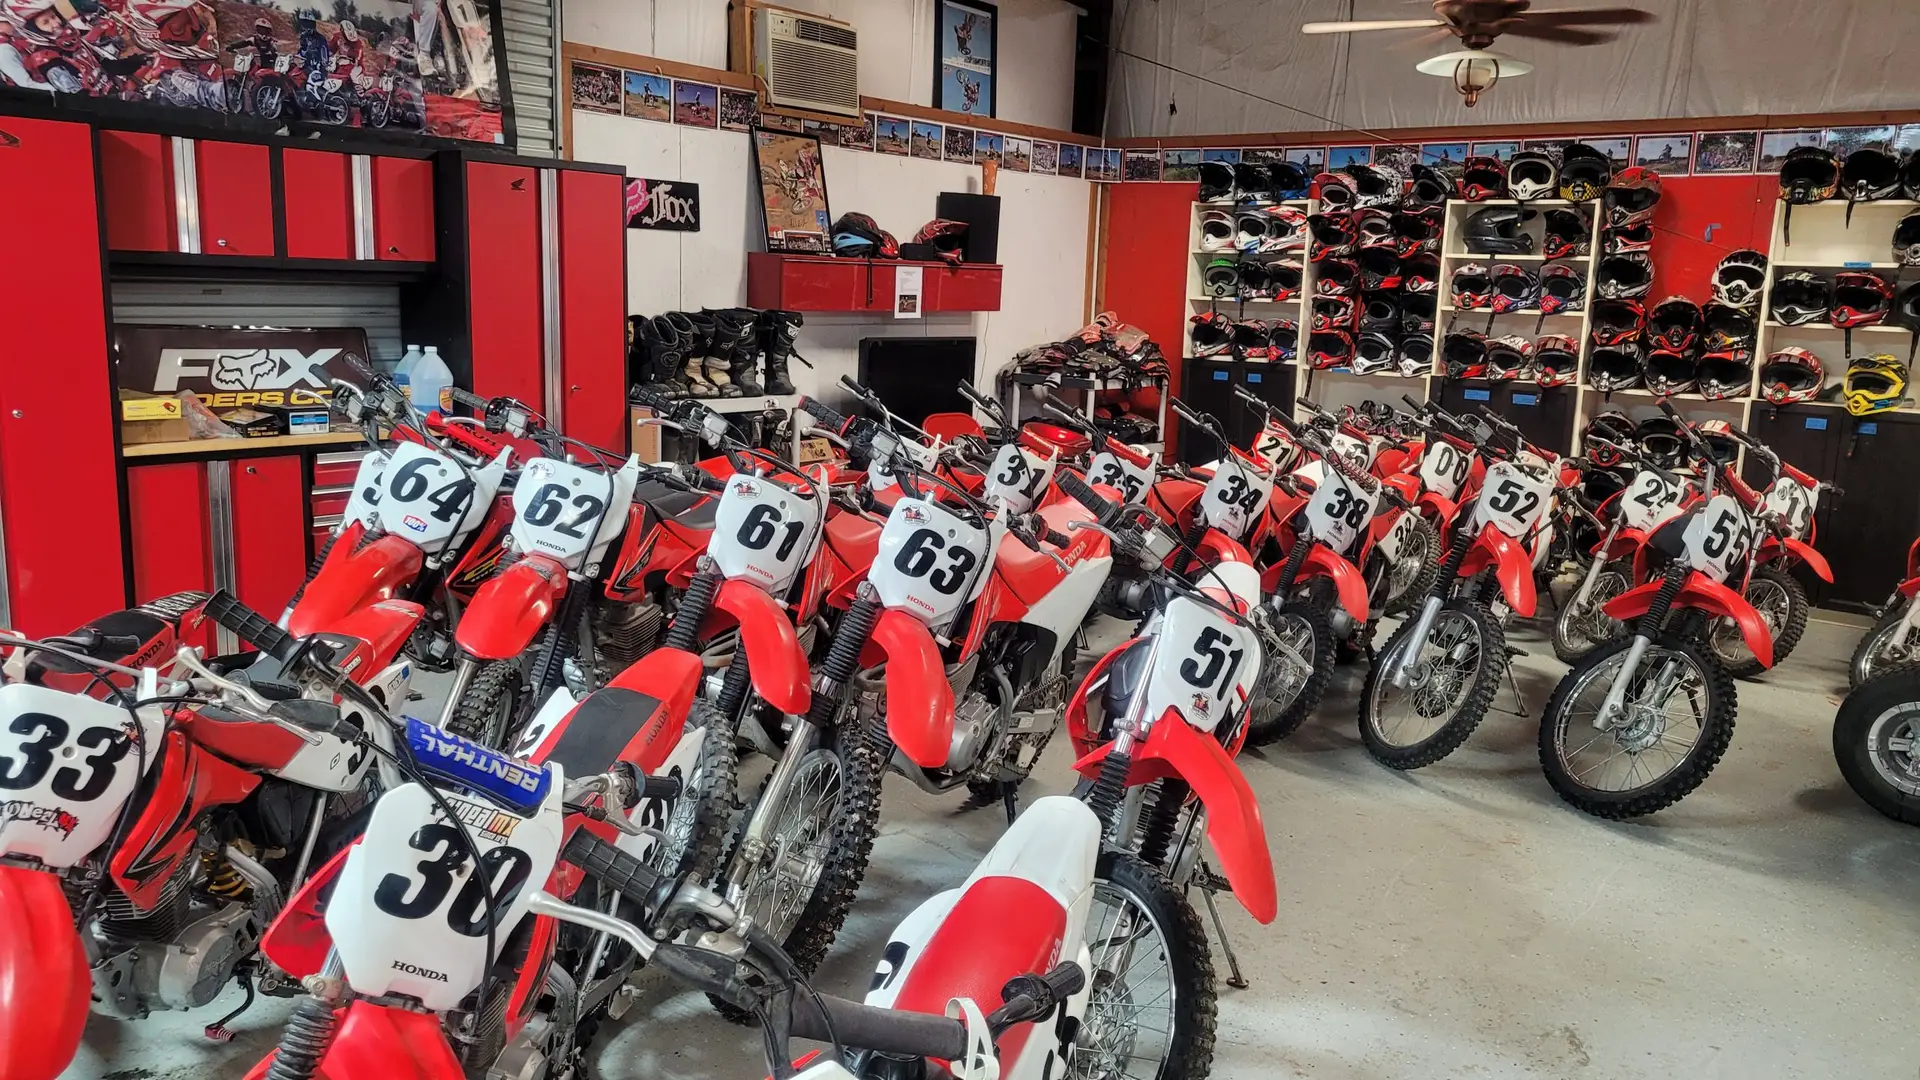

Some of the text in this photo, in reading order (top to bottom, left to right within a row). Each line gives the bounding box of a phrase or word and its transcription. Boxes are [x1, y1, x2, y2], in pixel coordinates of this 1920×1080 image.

[153, 348, 343, 391] FOX
[1258, 437, 1291, 466] 21
[389, 457, 477, 523] 64
[997, 454, 1046, 498] 31
[1091, 463, 1145, 503] 35
[1218, 475, 1263, 516] 34
[522, 483, 604, 539] 62
[1325, 487, 1370, 529] 38
[1489, 479, 1540, 525] 52
[535, 539, 567, 554] HONDA
[736, 503, 804, 562] 61
[1702, 508, 1751, 573] 55
[746, 563, 774, 581] HONDA
[893, 528, 977, 595] 63
[906, 594, 935, 615] HONDA
[1179, 625, 1244, 702] 51
[0, 712, 133, 802] 33
[421, 733, 541, 793] RENTHAL
[373, 823, 533, 938] 30
[391, 960, 450, 983] HONDA
